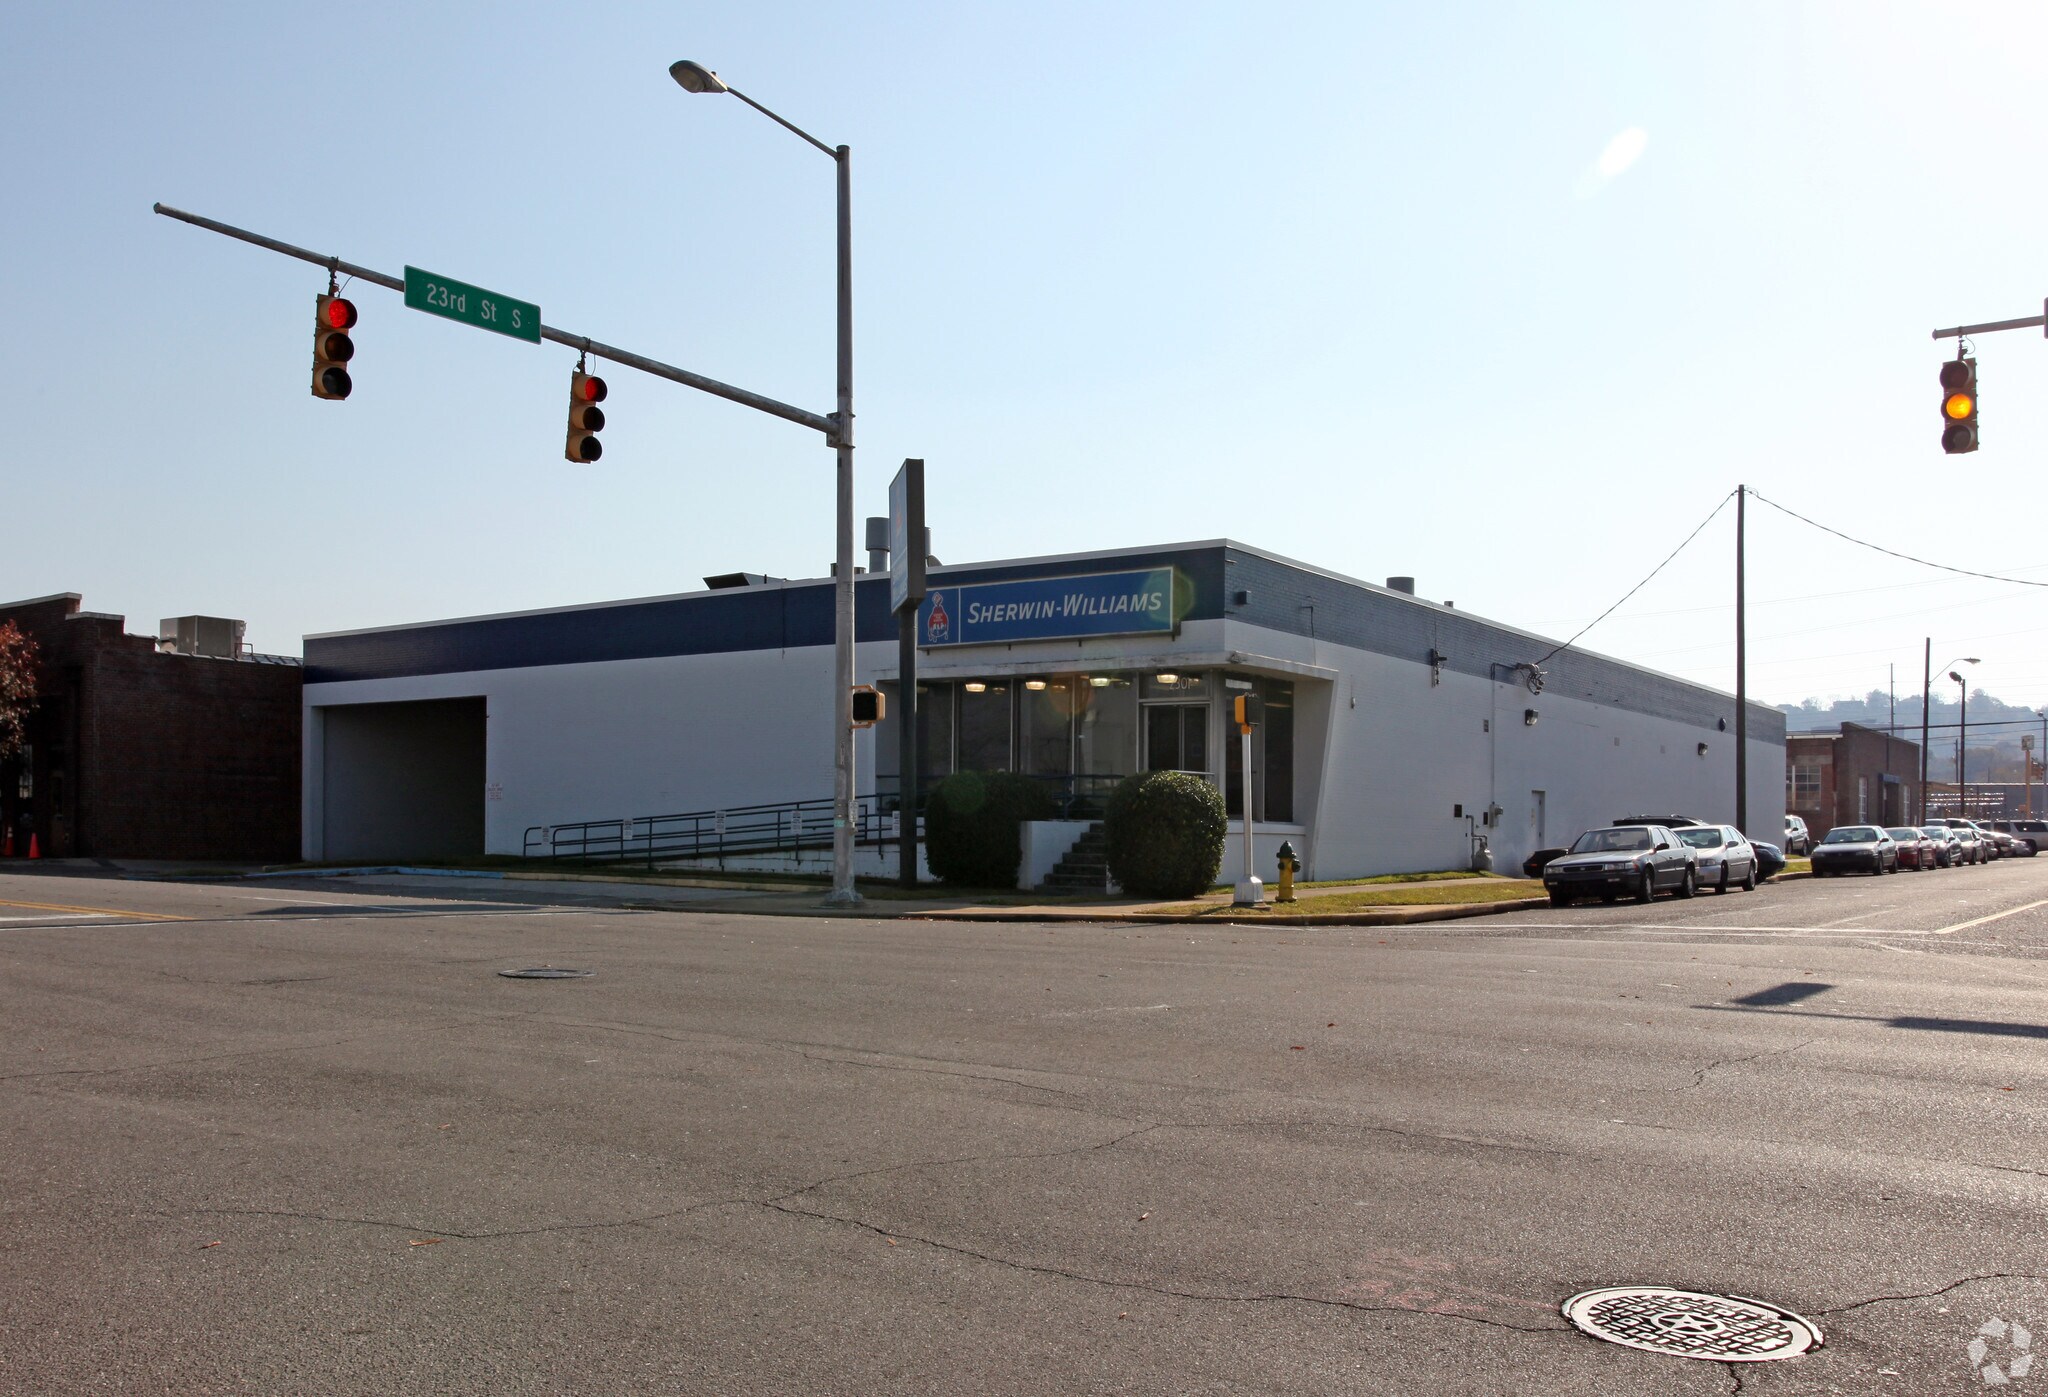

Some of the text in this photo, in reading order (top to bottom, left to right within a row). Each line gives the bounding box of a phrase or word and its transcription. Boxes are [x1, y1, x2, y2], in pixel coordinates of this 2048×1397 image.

[426, 283, 522, 329] 23rd St S
[967, 591, 1162, 625] SHERWIN-WILLIAMS
